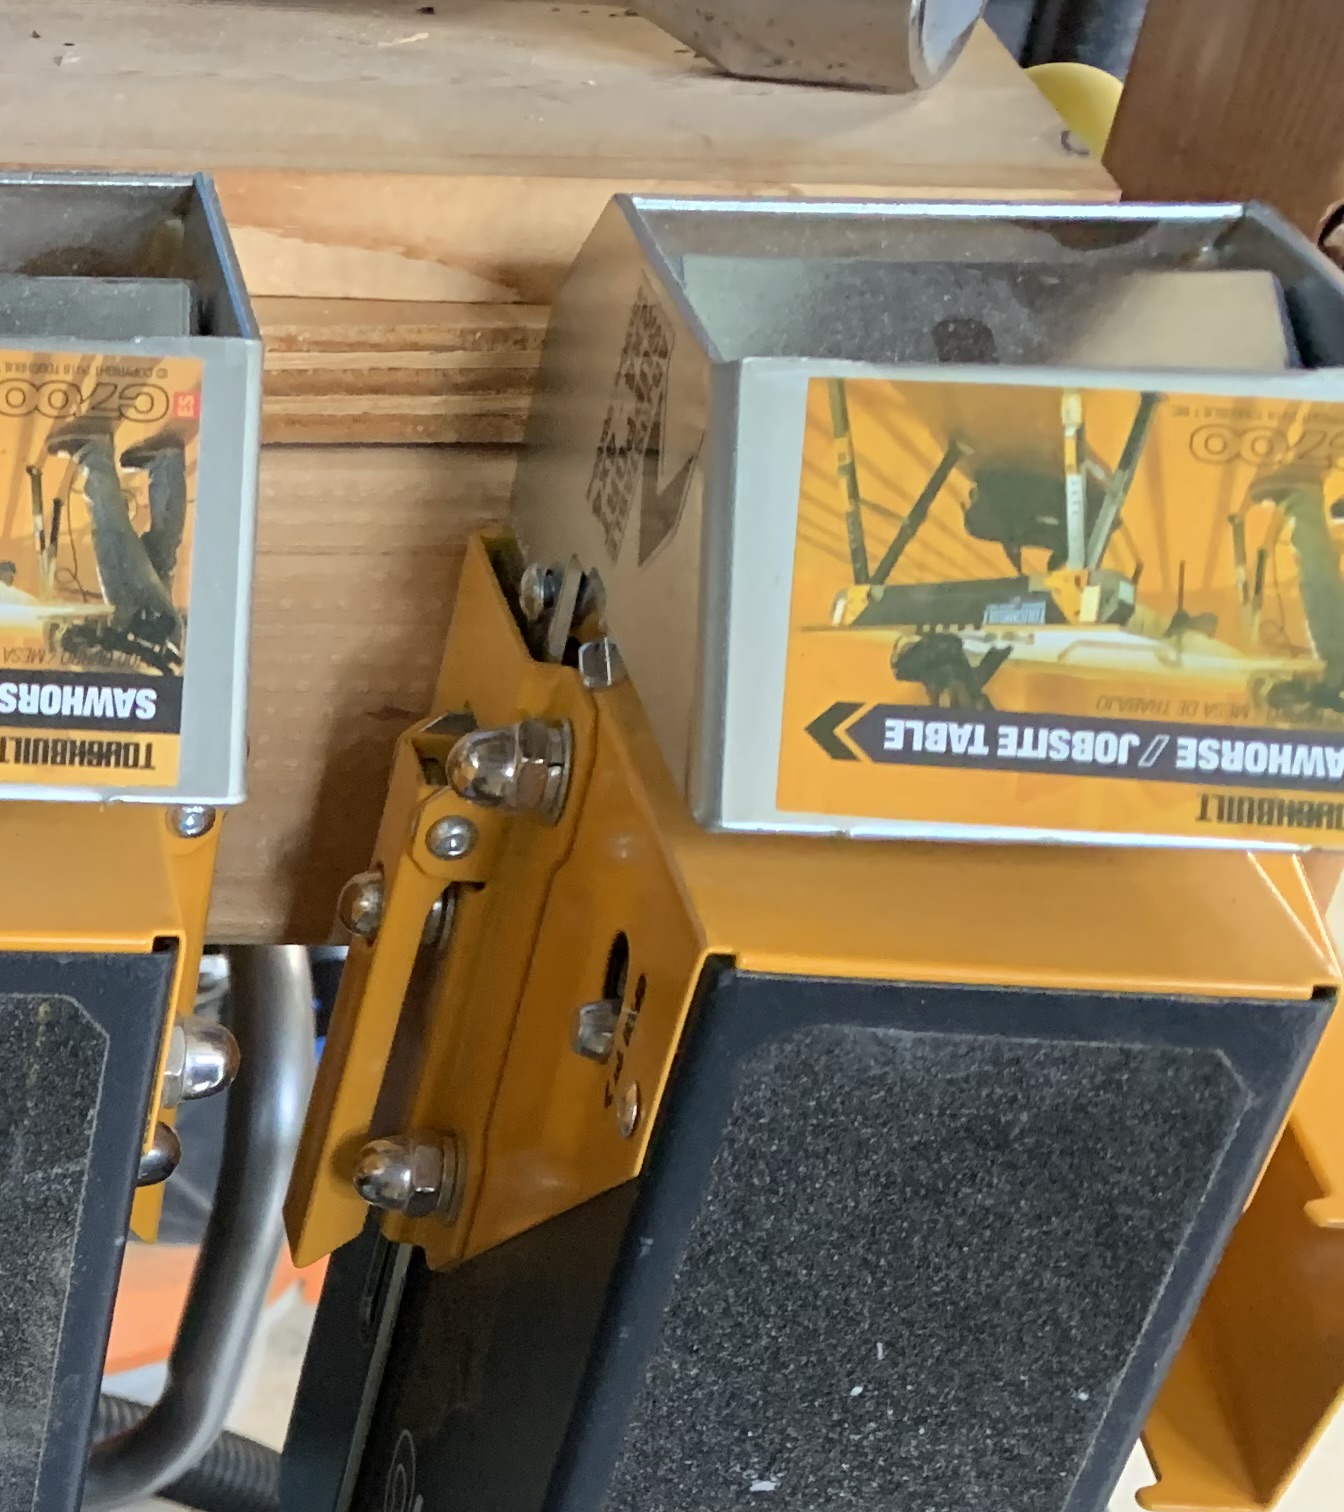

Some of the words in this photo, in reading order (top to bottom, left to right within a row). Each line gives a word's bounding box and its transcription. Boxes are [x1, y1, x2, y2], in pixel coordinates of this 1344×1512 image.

[883, 719, 989, 756] TABLE
[997, 725, 1140, 764] JOBSITE
[1176, 737, 1344, 779] AWHORSE
[1195, 794, 1344, 831] OUGHBUILT
